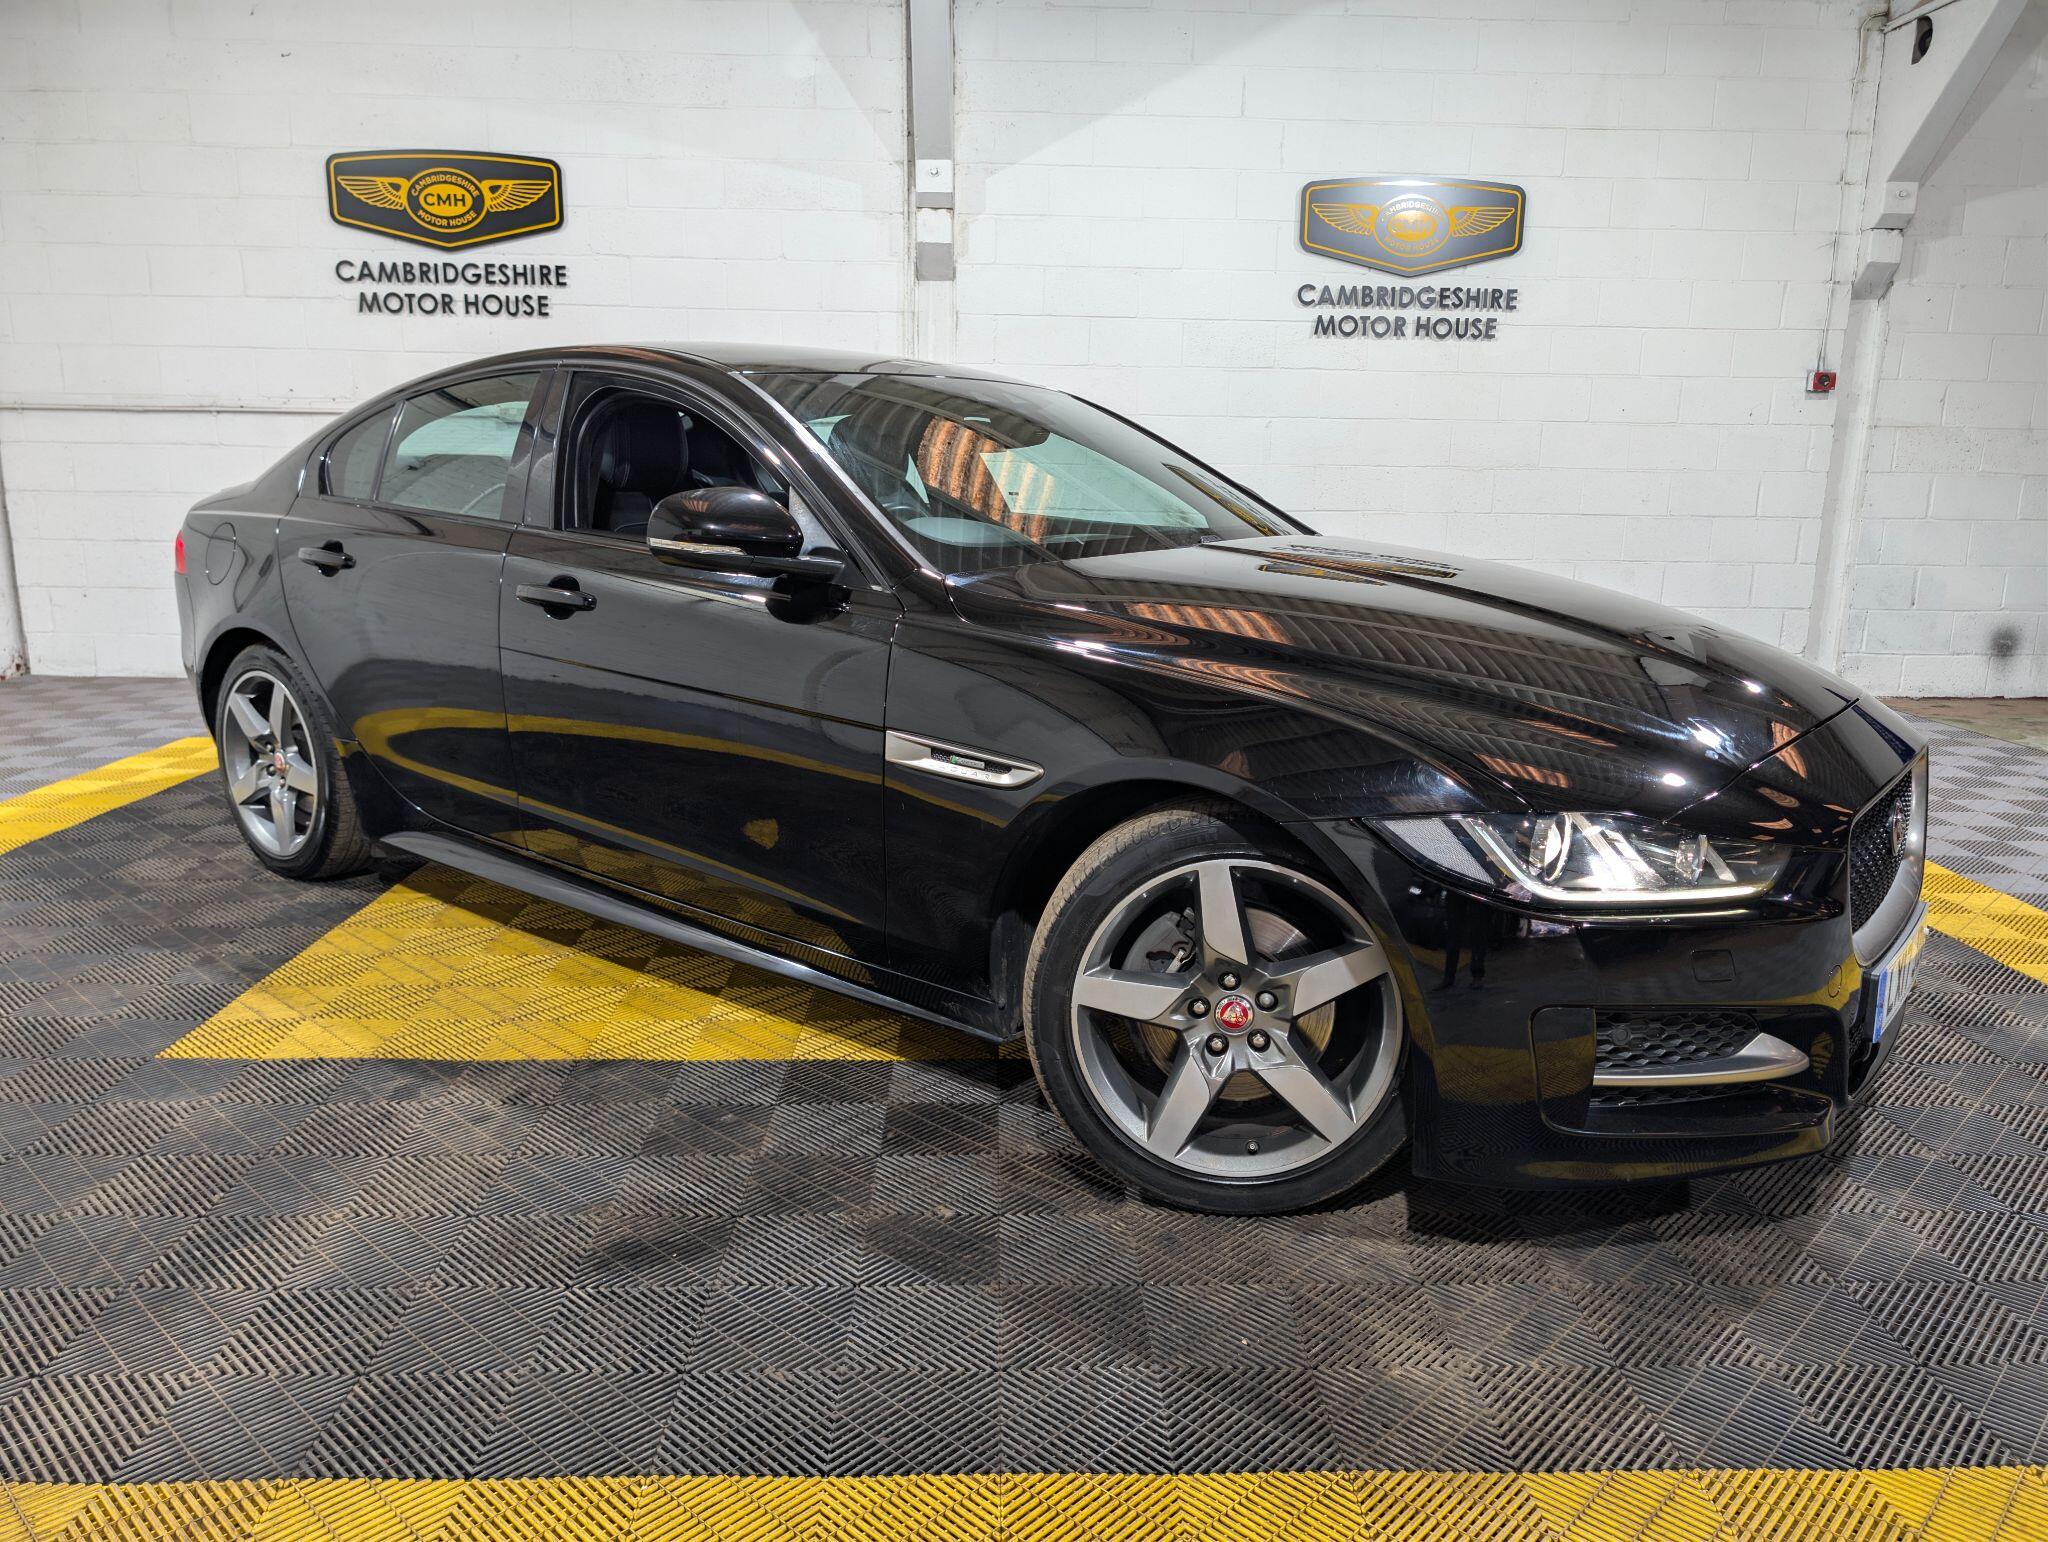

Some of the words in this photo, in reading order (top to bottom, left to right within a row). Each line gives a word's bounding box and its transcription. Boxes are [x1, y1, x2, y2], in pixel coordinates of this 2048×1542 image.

[411, 174, 480, 198] CAMBRIDGESHIRE
[423, 192, 467, 207] CMH
[417, 209, 448, 227] MOTOR
[449, 210, 478, 227] HOUSE
[335, 260, 568, 287] CAMBRIDGESHIRE
[358, 291, 455, 315] MOTOR
[465, 293, 550, 317] HOUSE
[1297, 283, 1519, 310] CAMBRIDGESHIRE
[1313, 314, 1407, 338] MOTOR
[1415, 316, 1498, 339] HOUSE
